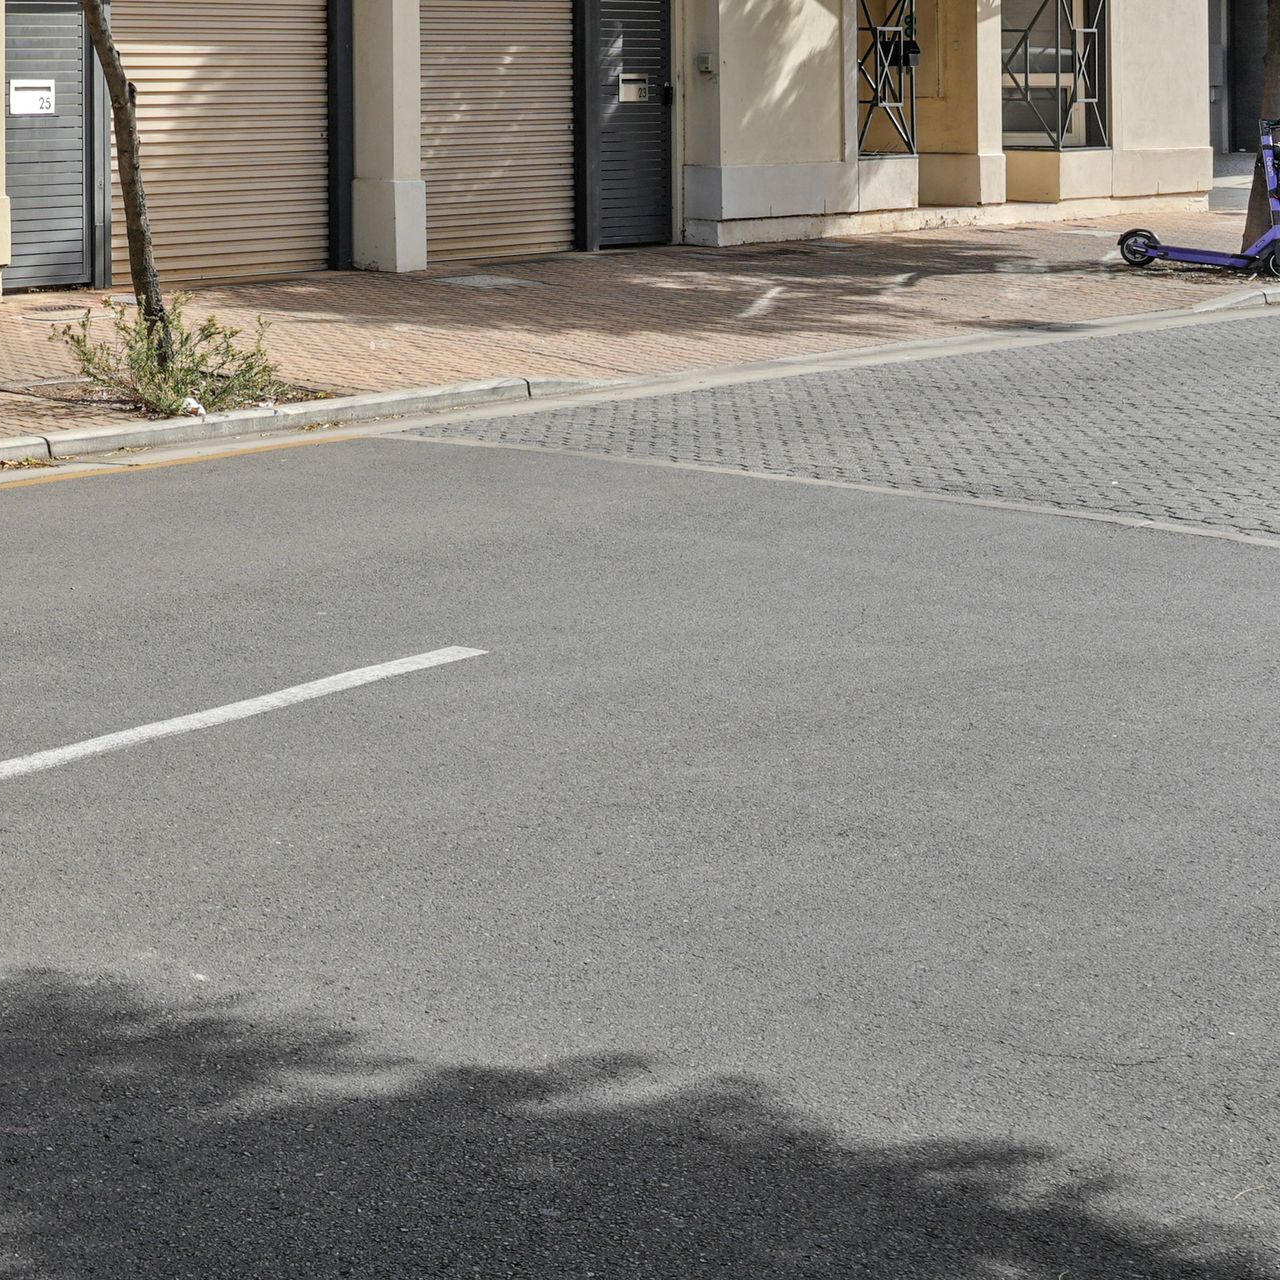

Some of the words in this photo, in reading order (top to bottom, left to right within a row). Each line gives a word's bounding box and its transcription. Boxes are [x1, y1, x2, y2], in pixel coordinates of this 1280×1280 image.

[638, 88, 647, 98] 23
[39, 96, 52, 110] 25
[1266, 157, 1274, 177] beam
